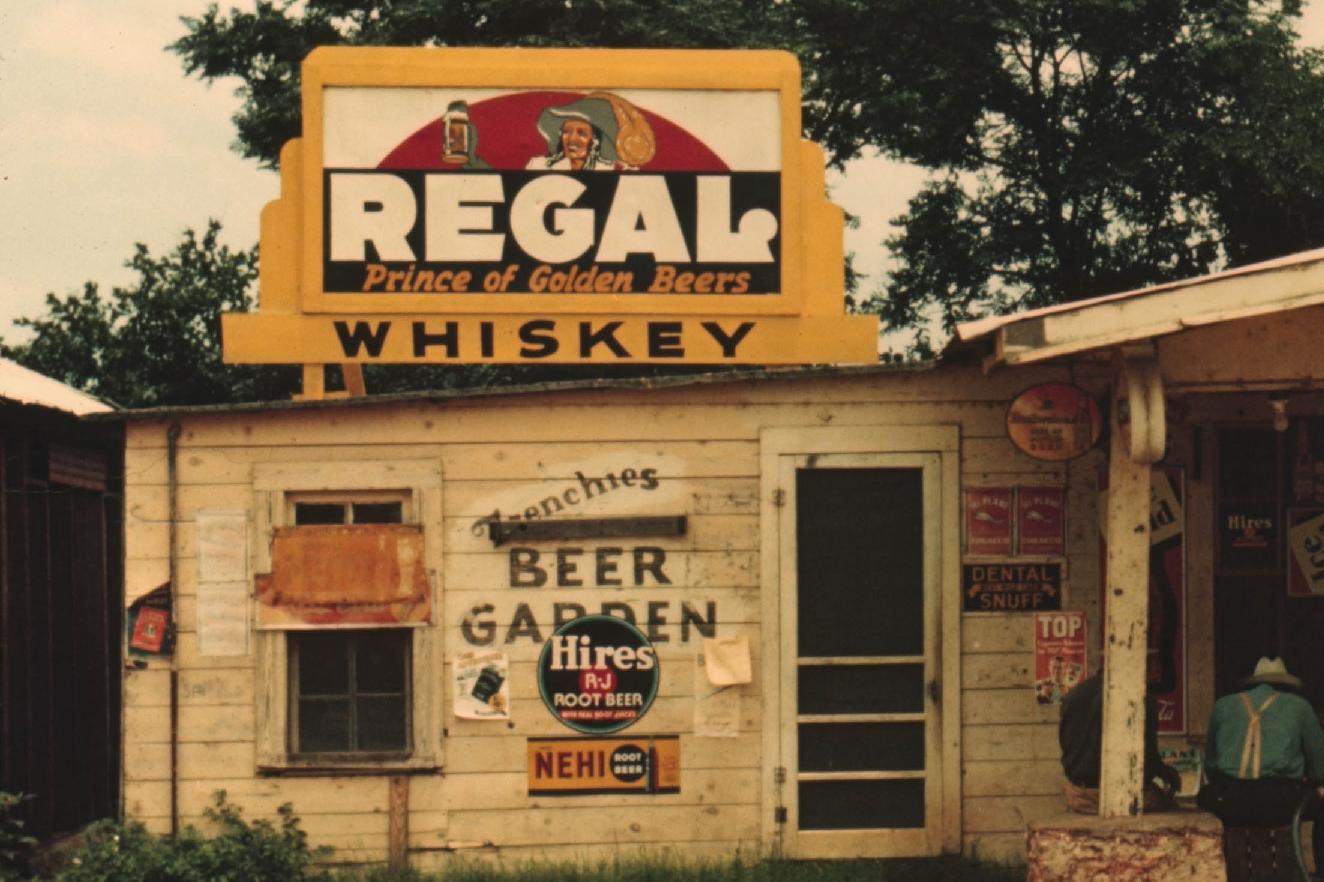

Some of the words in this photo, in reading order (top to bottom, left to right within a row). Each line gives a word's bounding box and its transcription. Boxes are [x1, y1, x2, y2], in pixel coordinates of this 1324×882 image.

[329, 172, 779, 263] REGAL
[361, 264, 471, 293] Prince
[483, 264, 517, 293] of
[528, 264, 634, 293] Golden
[649, 265, 751, 293] Beers
[334, 320, 757, 358] WHISKEY
[471, 467, 659, 538] Fenchies
[1227, 514, 1273, 529] Hires
[509, 546, 672, 588] BEER
[972, 566, 1052, 582] DENTAL
[980, 593, 1043, 609] SNUFF
[1038, 616, 1082, 638] TOP
[550, 635, 656, 670] Hires
[553, 692, 602, 707] ROOT
[605, 692, 643, 707] BEER
[535, 750, 605, 779] NEHI
[613, 753, 643, 762] ROOT
[613, 764, 643, 774] BEER
